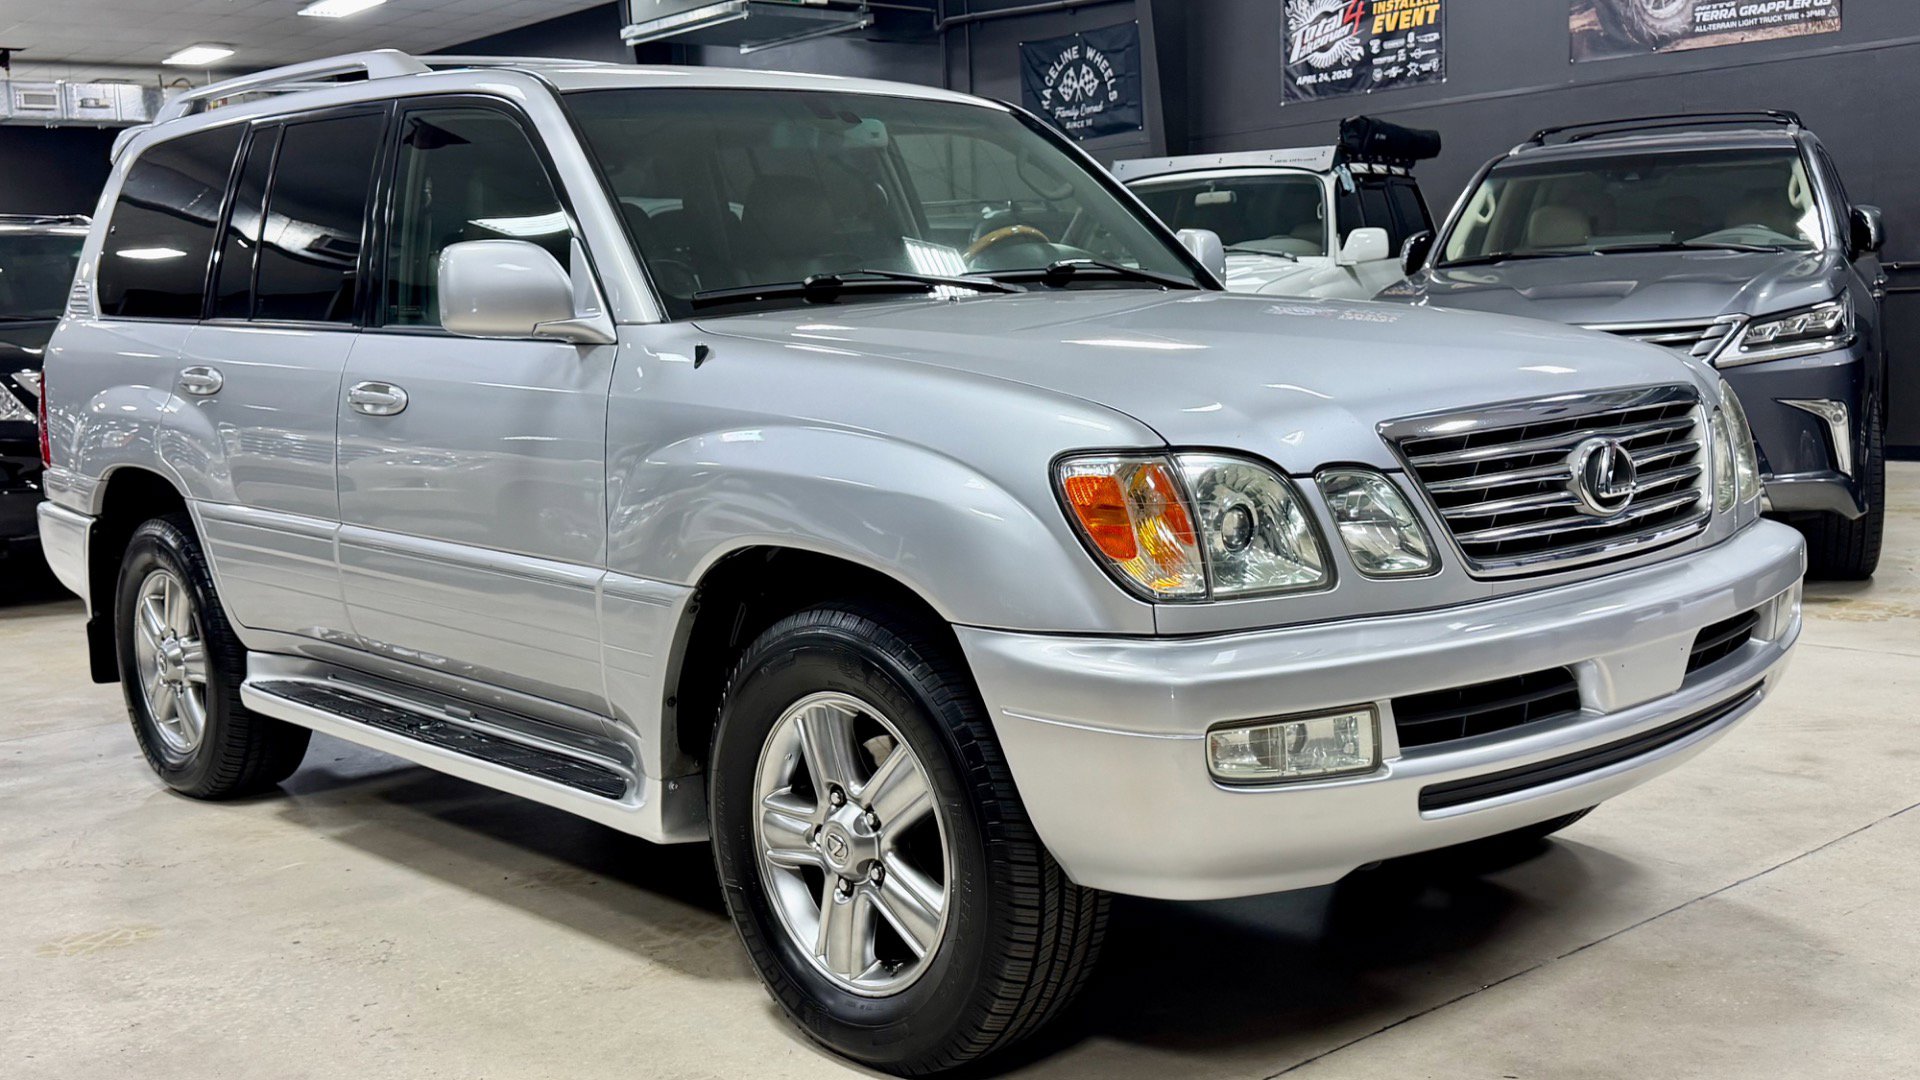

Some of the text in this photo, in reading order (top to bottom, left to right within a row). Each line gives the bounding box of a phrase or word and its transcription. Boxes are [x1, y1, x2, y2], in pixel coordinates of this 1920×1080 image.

[1343, 0, 1365, 36] 4
[1371, 4, 1440, 36] EVENT
[1694, 7, 1737, 22] TERRA
[1739, 0, 1811, 16] GRAPPLER
[1694, 21, 1737, 32] ALL-TERRAIN
[1738, 18, 1759, 27] LIGHT
[1759, 15, 1783, 24] TRUCK
[1783, 12, 1800, 20] TIRE
[1041, 45, 1118, 110] RACELINE WHEELS
[1295, 74, 1317, 86] APRIL
[1331, 68, 1353, 80] 2026
